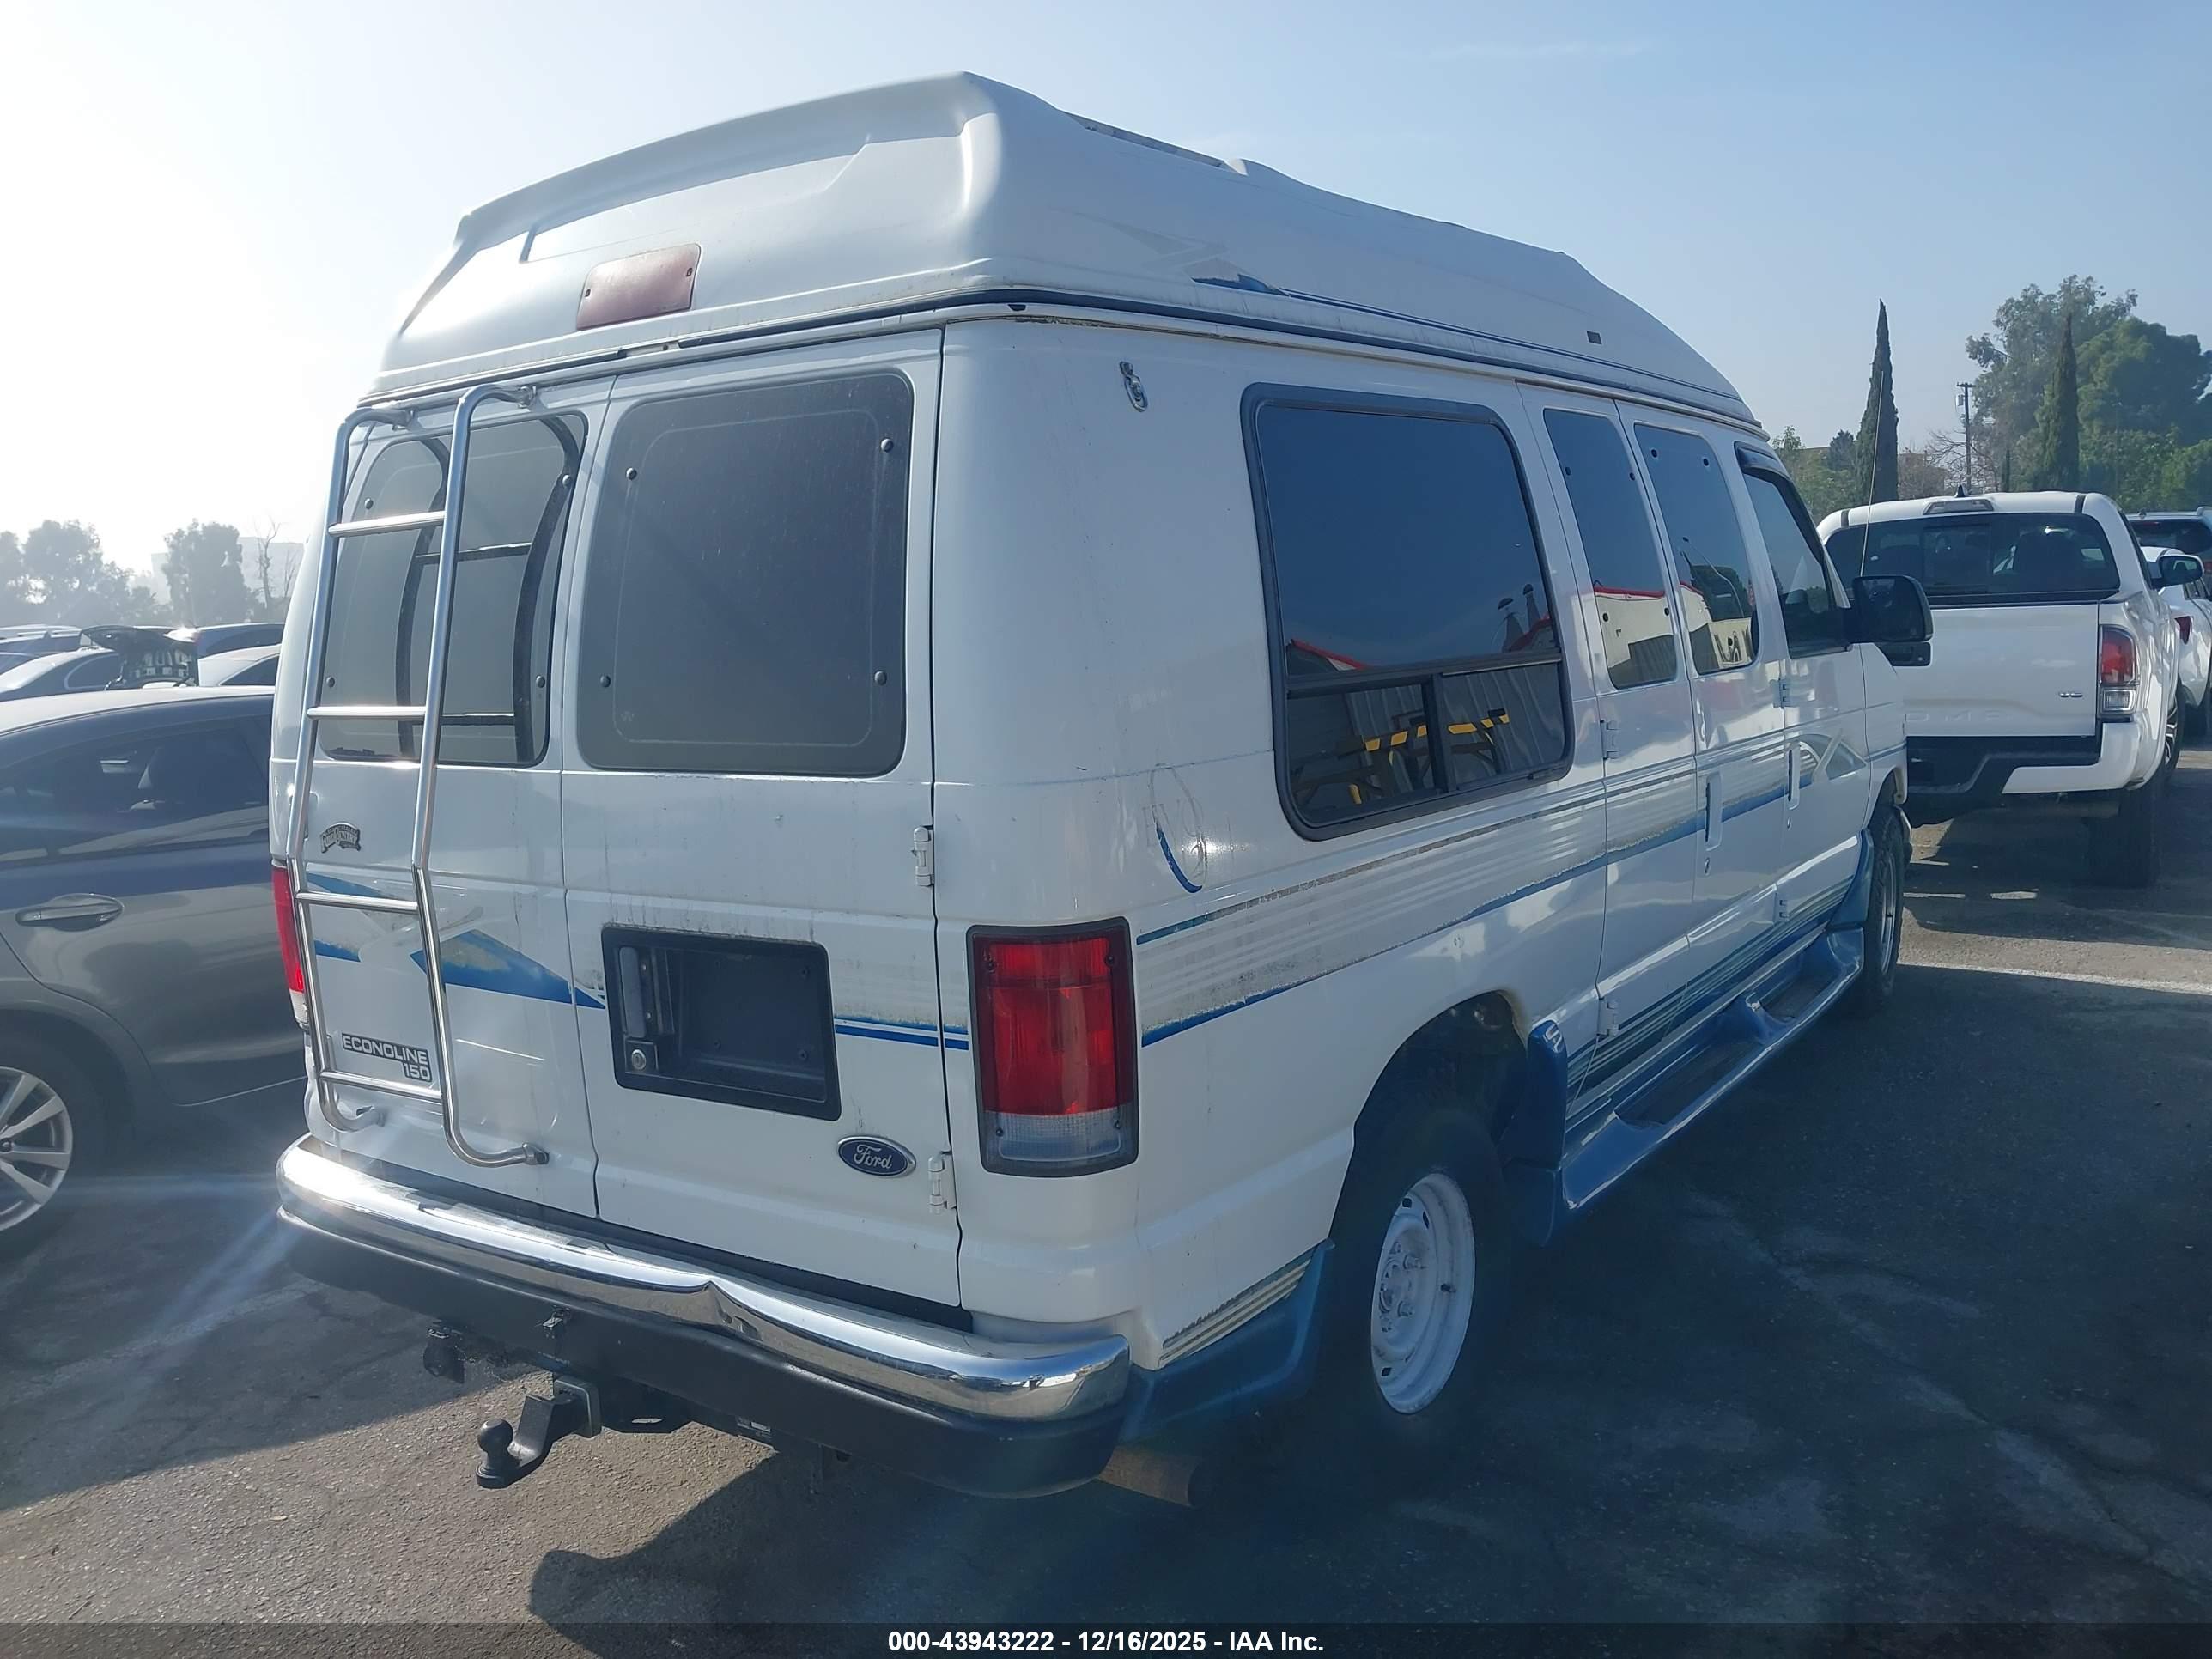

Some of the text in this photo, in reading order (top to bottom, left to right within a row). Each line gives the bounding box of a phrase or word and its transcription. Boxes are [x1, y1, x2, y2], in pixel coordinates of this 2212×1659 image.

[342, 1034, 428, 1066] ECONOLINE
[404, 1063, 431, 1081] 150
[854, 1144, 892, 1169] Ford
